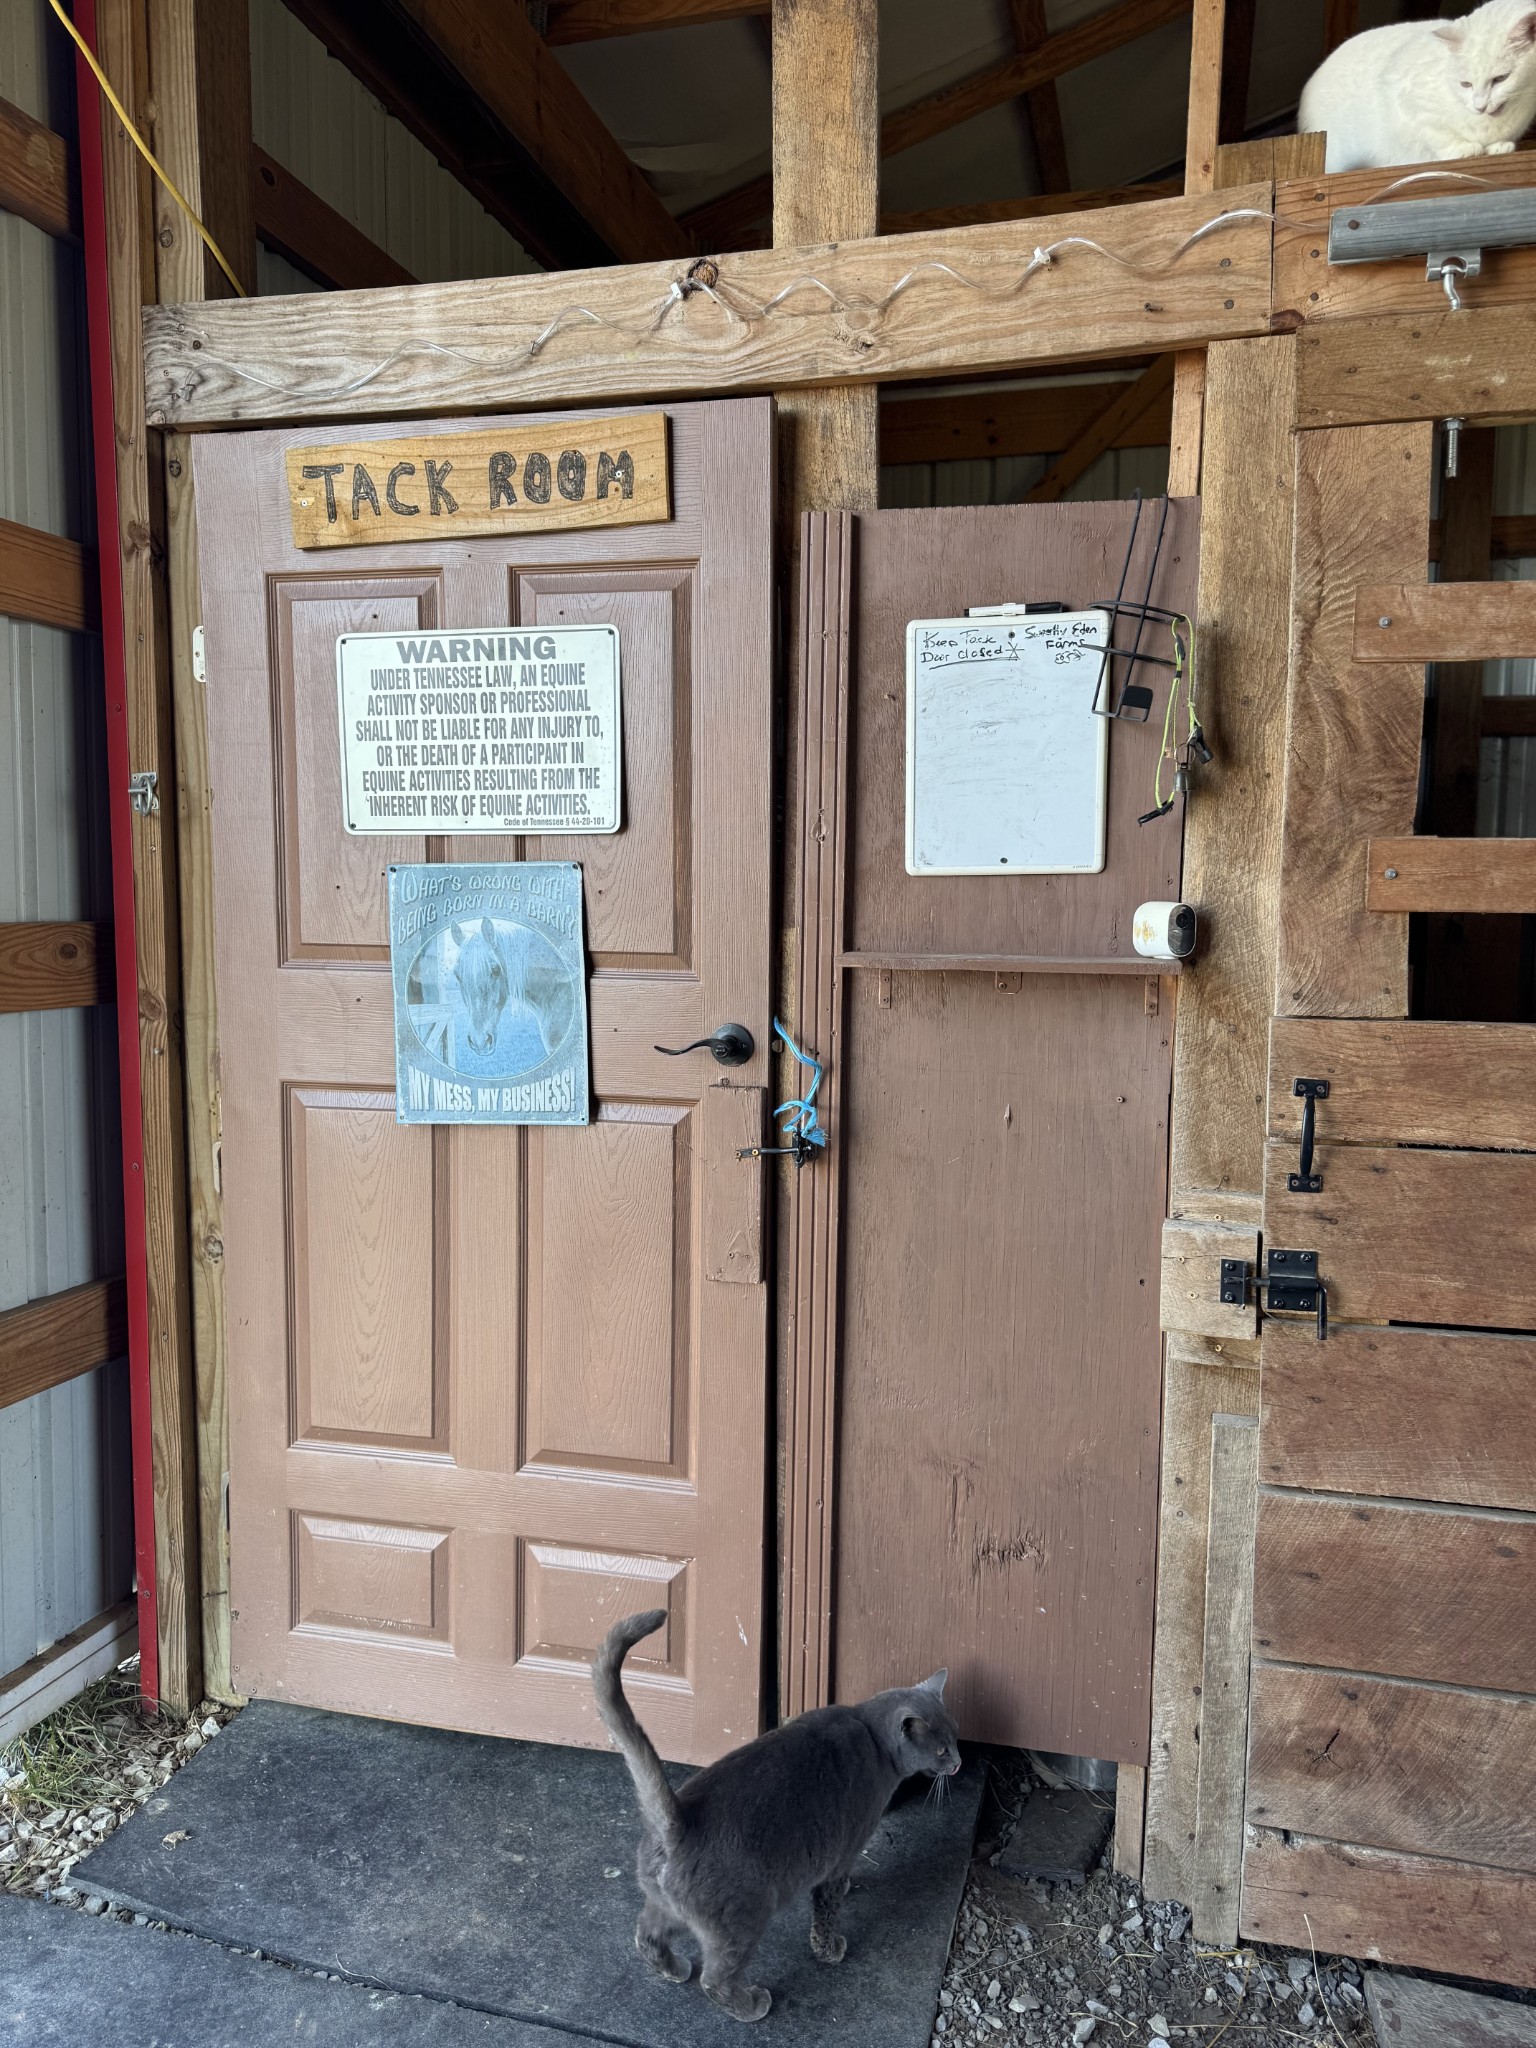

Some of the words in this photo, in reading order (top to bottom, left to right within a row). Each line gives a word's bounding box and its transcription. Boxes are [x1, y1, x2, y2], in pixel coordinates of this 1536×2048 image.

[302, 460, 459, 524] TACK
[489, 450, 635, 510] ROOM
[397, 636, 557, 664] WARNING
[923, 632, 958, 649] Keep
[960, 629, 996, 644] Tack
[1046, 638, 1085, 649] Farms
[921, 652, 950, 663] Door
[371, 668, 410, 690] UNDER
[413, 666, 482, 689] TENNESSEE
[486, 665, 517, 690] LAW,
[520, 665, 537, 686] AN
[541, 663, 585, 688] EQUINE
[367, 694, 416, 716] ACTIVITY
[420, 692, 477, 715] SPONSOR
[481, 692, 497, 713] OR
[500, 689, 591, 713] PROFESSIONAL
[356, 720, 392, 742] SHALL
[396, 720, 418, 740] NOT
[423, 719, 437, 740] BE
[441, 718, 480, 740] LIABLE
[484, 717, 506, 739] FOR
[510, 717, 534, 738] ANY
[538, 716, 582, 738] INJURY
[585, 715, 603, 740] TO,
[377, 746, 393, 766] OR
[396, 745, 419, 766] THE
[421, 744, 458, 765] DEATH
[462, 744, 476, 765] OF
[480, 744, 488, 764] A
[492, 743, 568, 764] PARTICIPANT
[571, 742, 584, 763] IN
[363, 771, 405, 794] EQUINE
[409, 770, 471, 792] ACTIVITIES
[475, 769, 537, 790] RESULTING
[541, 768, 575, 789] FROM
[578, 767, 600, 789] THE
[369, 796, 427, 817] INHERENT
[431, 795, 458, 816] RISK
[462, 795, 476, 815] OF
[480, 794, 522, 818] EQUINE
[525, 793, 591, 815] ACTIVITIES.
[530, 818, 564, 826] Tennessee
[571, 817, 604, 825] 44-20-101
[402, 871, 462, 905] WHAT'S
[468, 874, 521, 892] WRONG
[528, 875, 566, 903] WITH
[397, 903, 437, 945] BEING
[443, 894, 481, 916] BORN
[489, 894, 505, 909] IN
[510, 896, 520, 912] A
[527, 904, 576, 939] BARN?
[408, 1065, 431, 1111] MY
[433, 1078, 476, 1115] MESS,
[477, 1087, 500, 1112] MY
[502, 1067, 576, 1113] BUSINESS!
